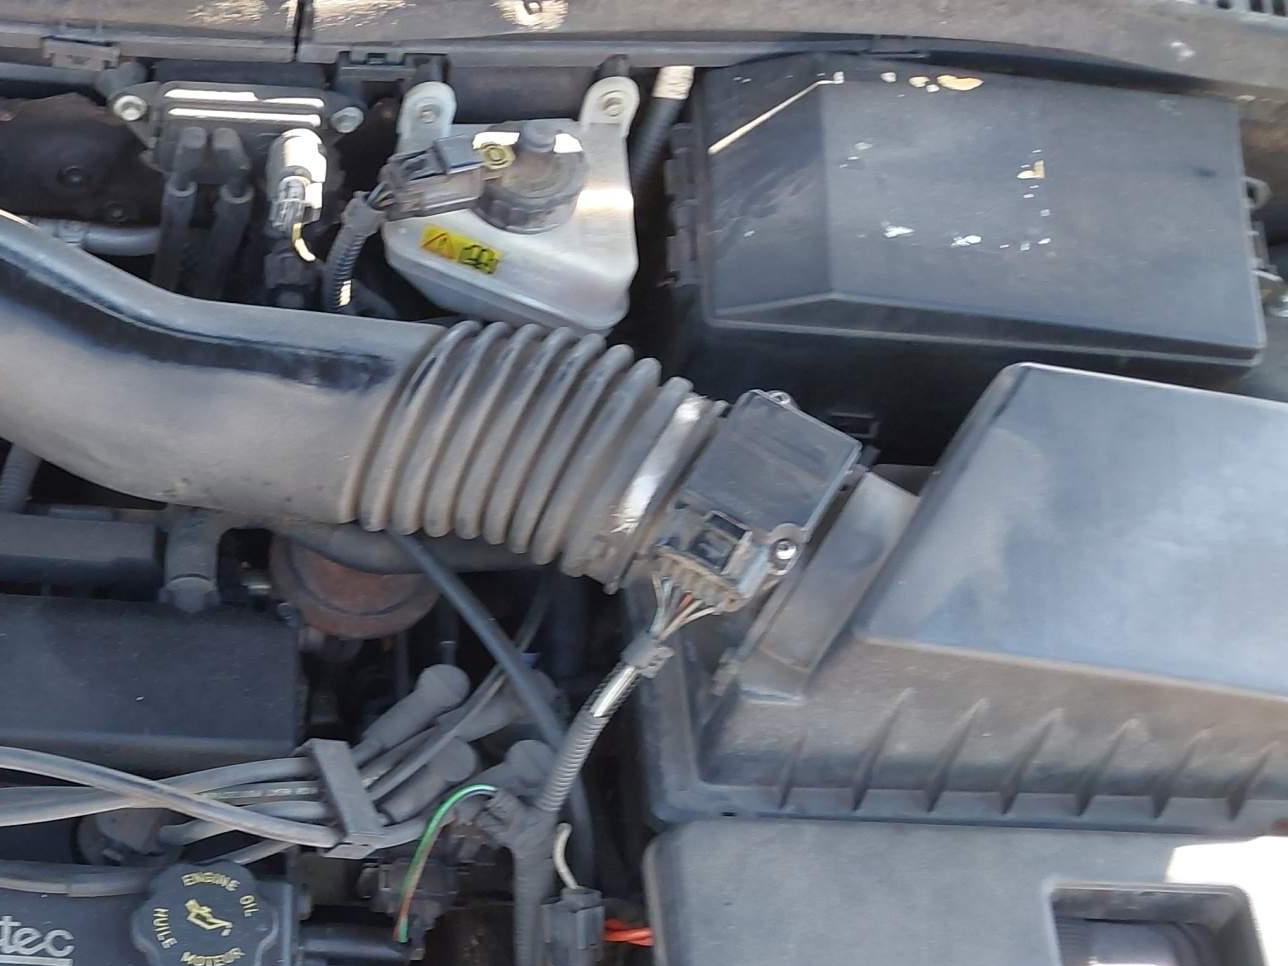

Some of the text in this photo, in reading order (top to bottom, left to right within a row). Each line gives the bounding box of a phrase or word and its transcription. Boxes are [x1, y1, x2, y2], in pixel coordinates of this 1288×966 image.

[182, 872, 260, 918] ENGINE OIL
[153, 908, 247, 966] HUILE MOTEUR
